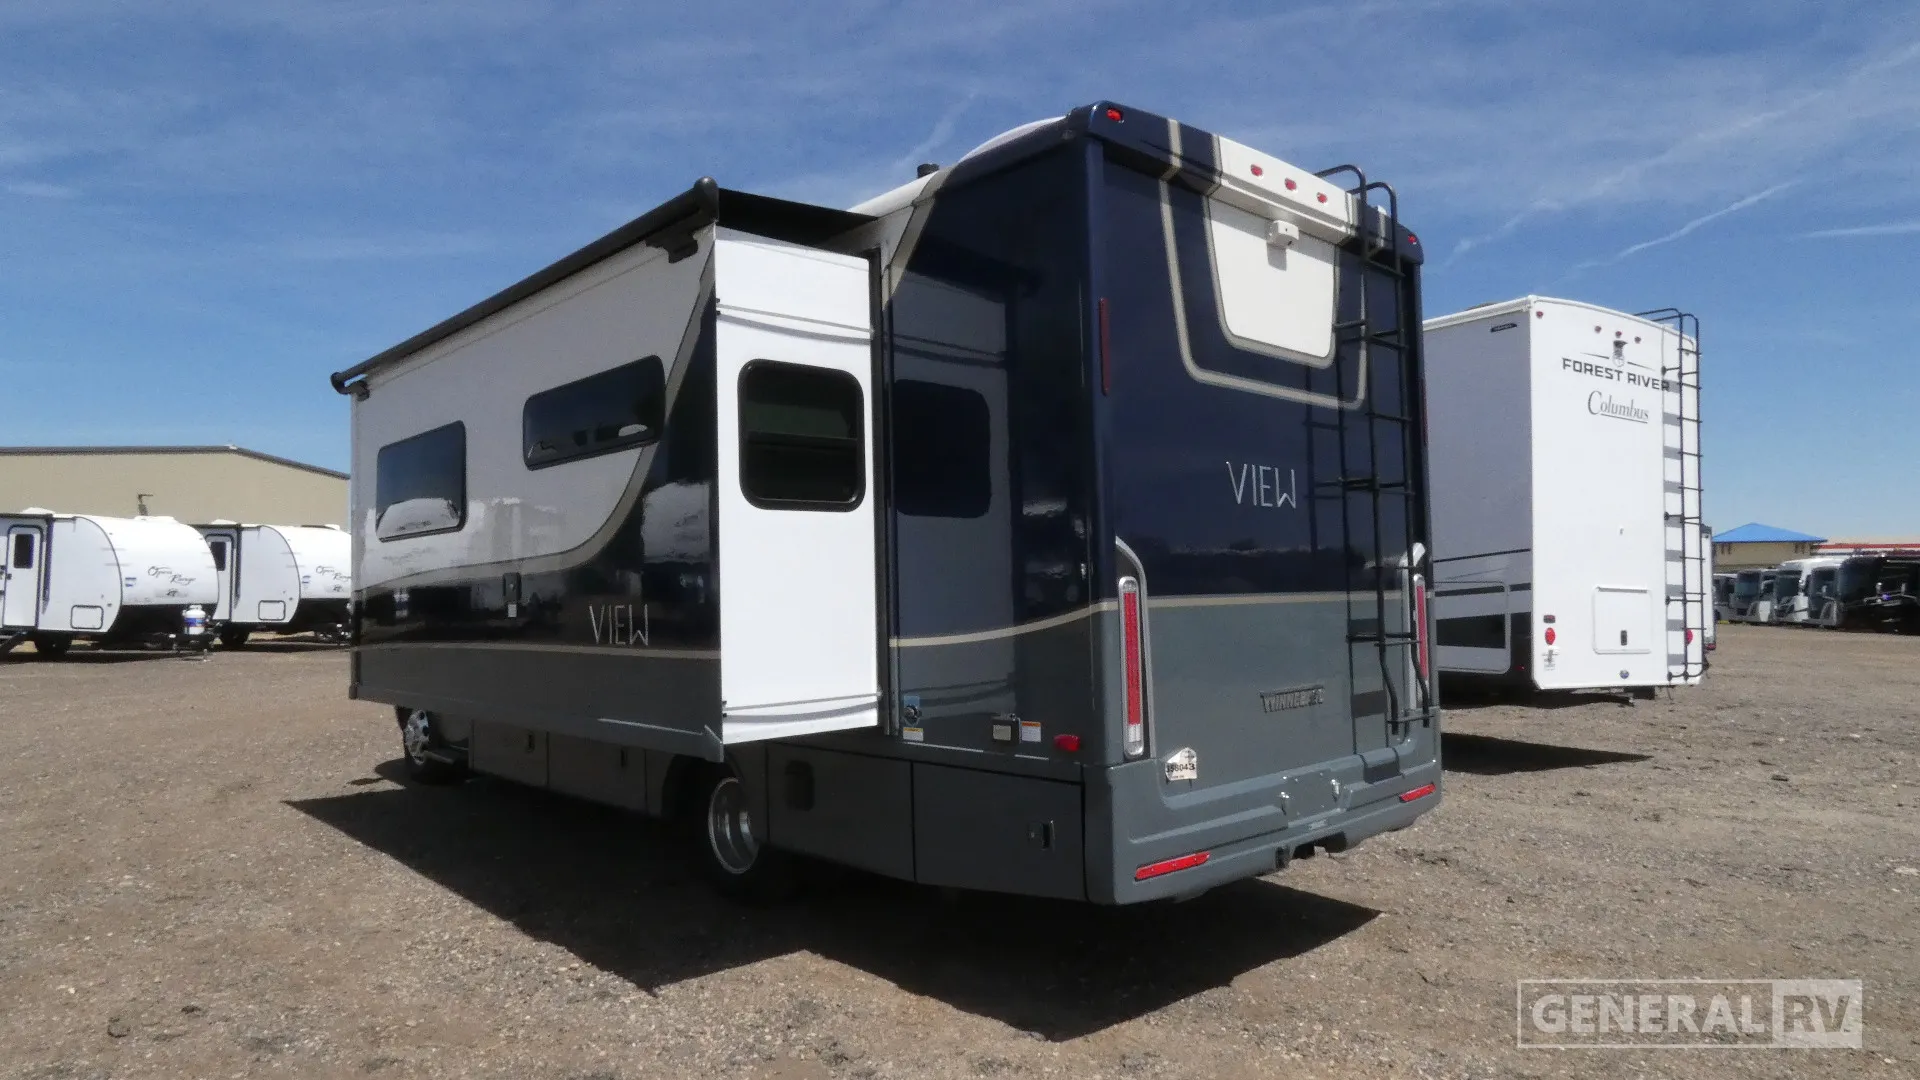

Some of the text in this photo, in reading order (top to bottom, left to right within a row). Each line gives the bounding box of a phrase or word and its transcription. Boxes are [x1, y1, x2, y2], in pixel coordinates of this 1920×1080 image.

[1562, 357, 1670, 392] FOREST RIVER
[1587, 390, 1649, 420] Columbus
[1226, 461, 1297, 509] VIEW
[148, 566, 173, 578] Open
[589, 604, 649, 646] VIEW
